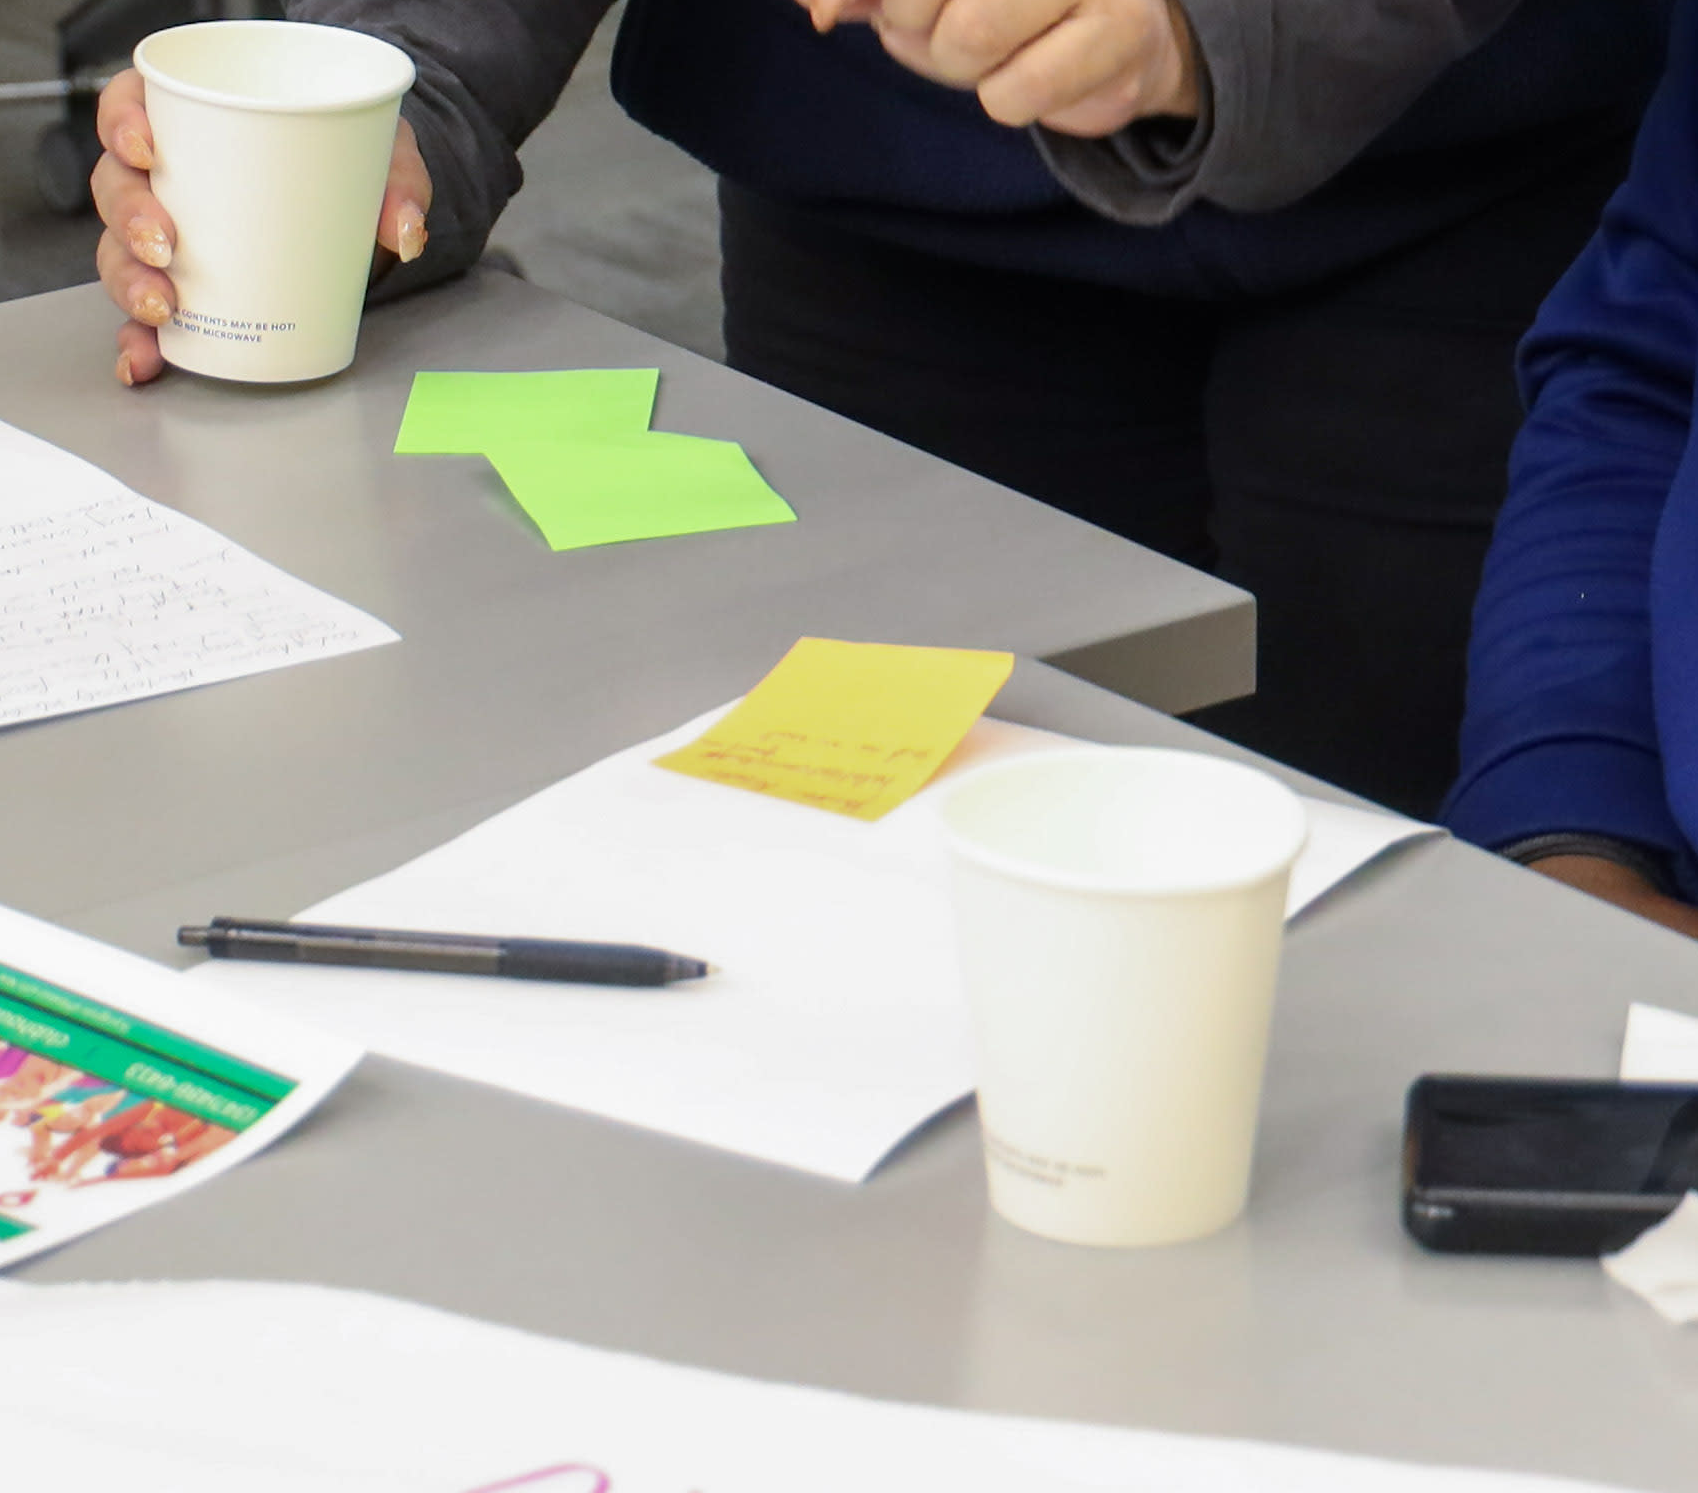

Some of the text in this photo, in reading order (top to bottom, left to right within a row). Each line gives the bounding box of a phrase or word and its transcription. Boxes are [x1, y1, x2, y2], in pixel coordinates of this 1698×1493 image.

[172, 318, 263, 344] DO NOT MICROWAVE
[180, 308, 296, 332] CONTENTS MAY BE HOT!
